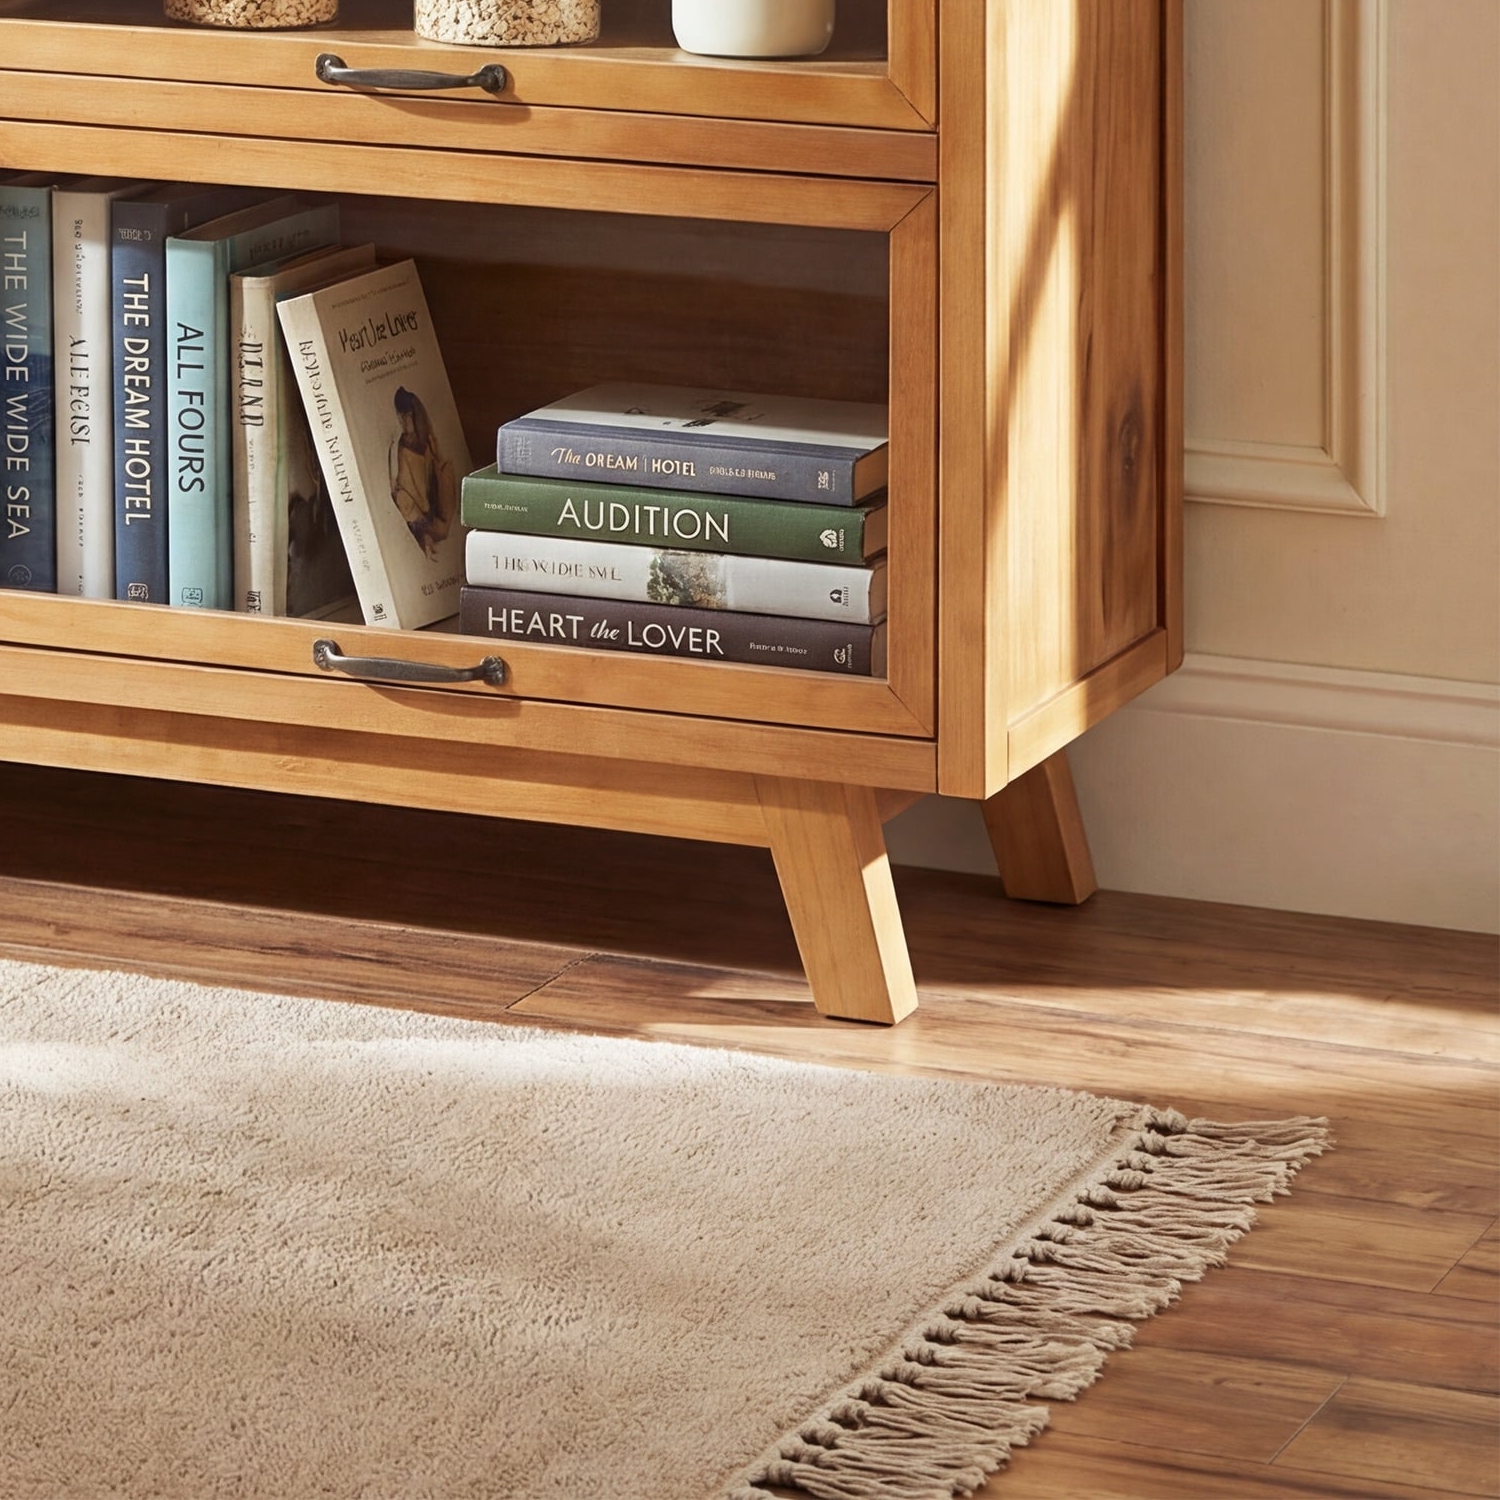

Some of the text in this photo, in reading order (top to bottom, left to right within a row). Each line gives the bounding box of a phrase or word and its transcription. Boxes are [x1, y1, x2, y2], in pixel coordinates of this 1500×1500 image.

[4, 231, 27, 290] THE
[123, 273, 150, 327] THE
[5, 303, 29, 381] WIDE
[123, 337, 151, 429] DREAM
[177, 322, 205, 493] ALL FOURS
[6, 394, 30, 472] WIDE
[124, 438, 152, 526] HOTEL
[651, 458, 696, 477] HOTEL
[7, 485, 31, 539] SEA
[557, 498, 729, 543] AUDITION
[488, 606, 725, 655] HEART the LOVER
